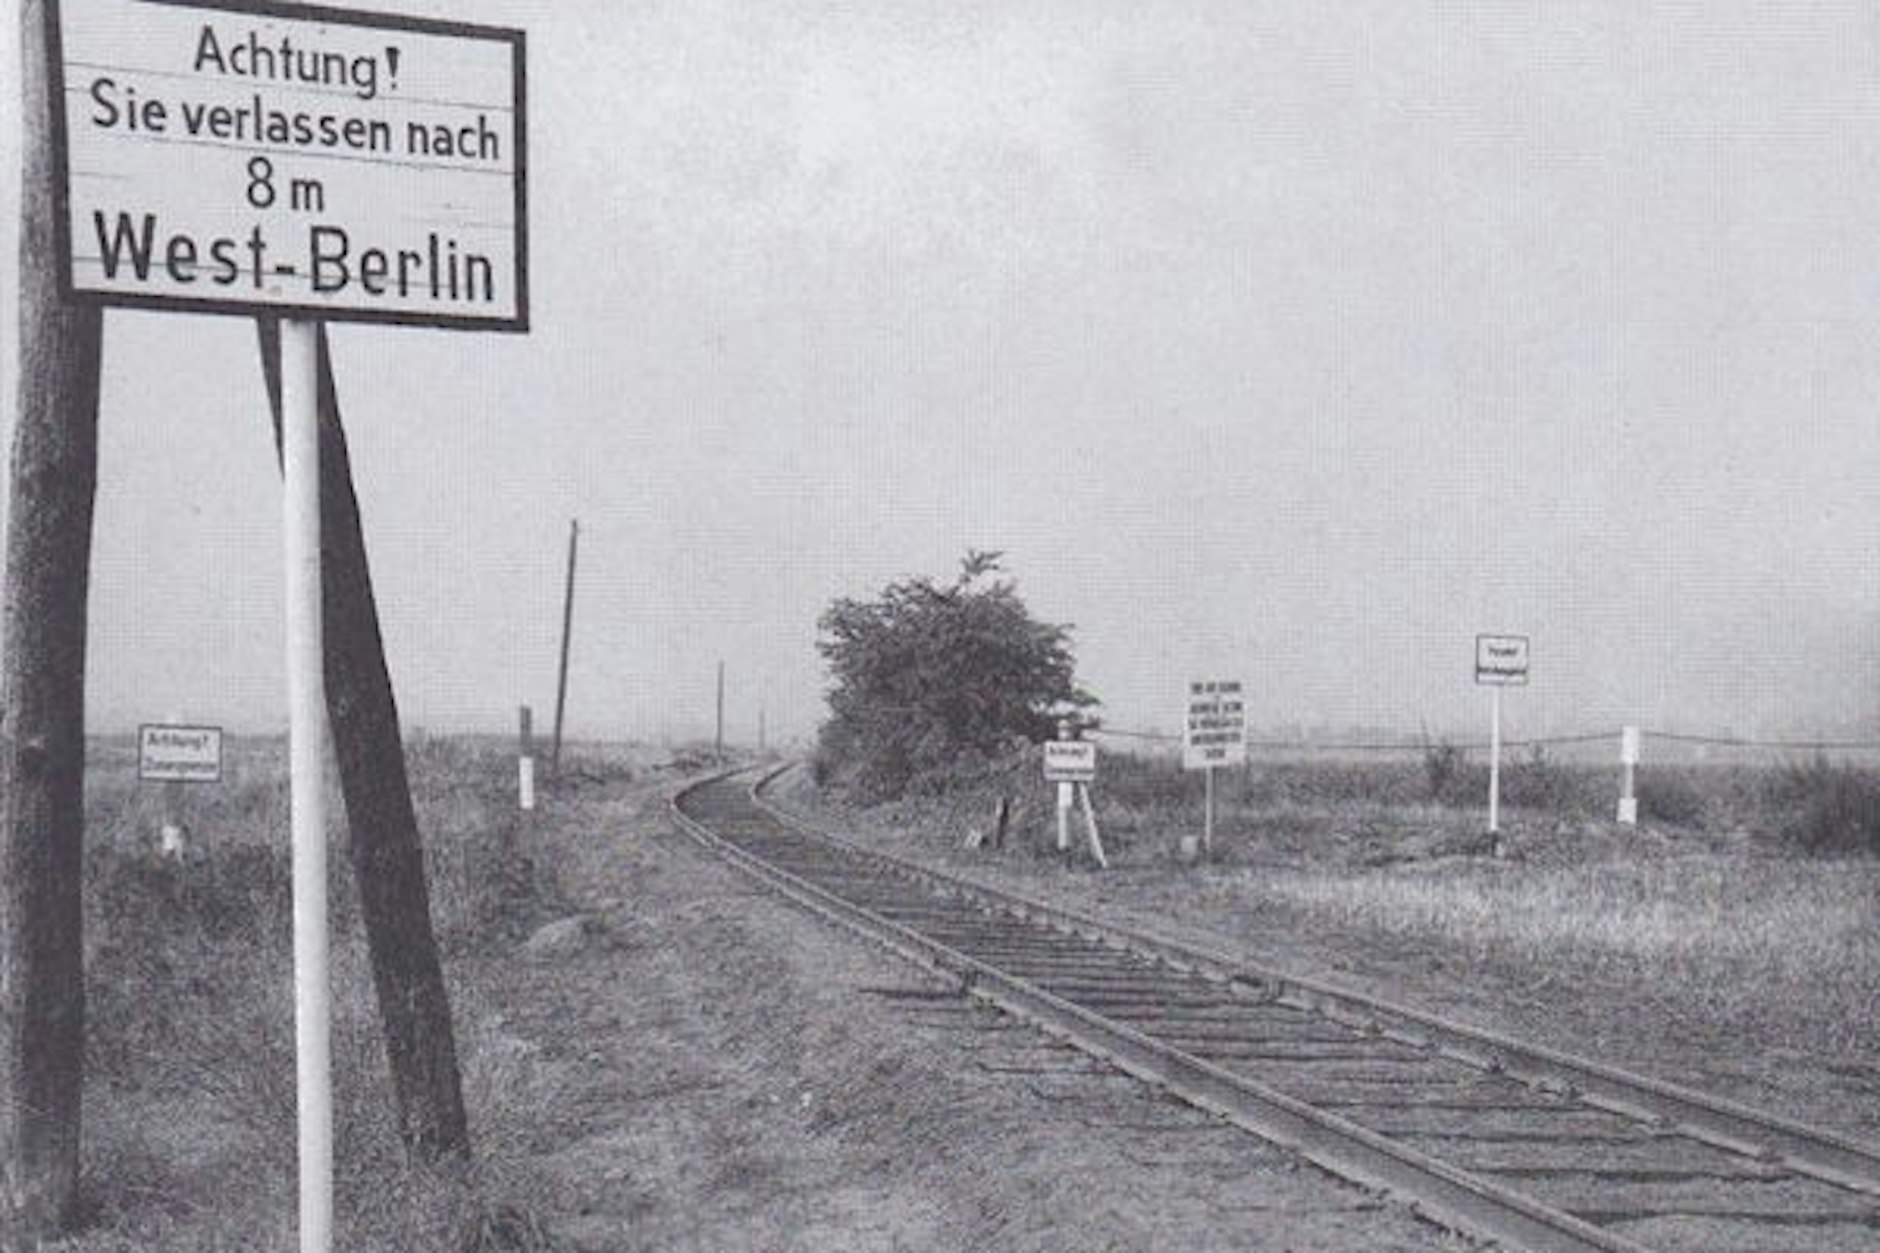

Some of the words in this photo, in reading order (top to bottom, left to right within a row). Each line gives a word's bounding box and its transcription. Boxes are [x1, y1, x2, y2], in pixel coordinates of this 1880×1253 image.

[194, 25, 401, 98] Achtung!
[90, 79, 168, 132] Sie
[181, 95, 392, 152] verlassen
[406, 115, 500, 161] nach
[246, 156, 276, 209] 8
[290, 177, 324, 212] m
[94, 209, 495, 302] West-Berlin
